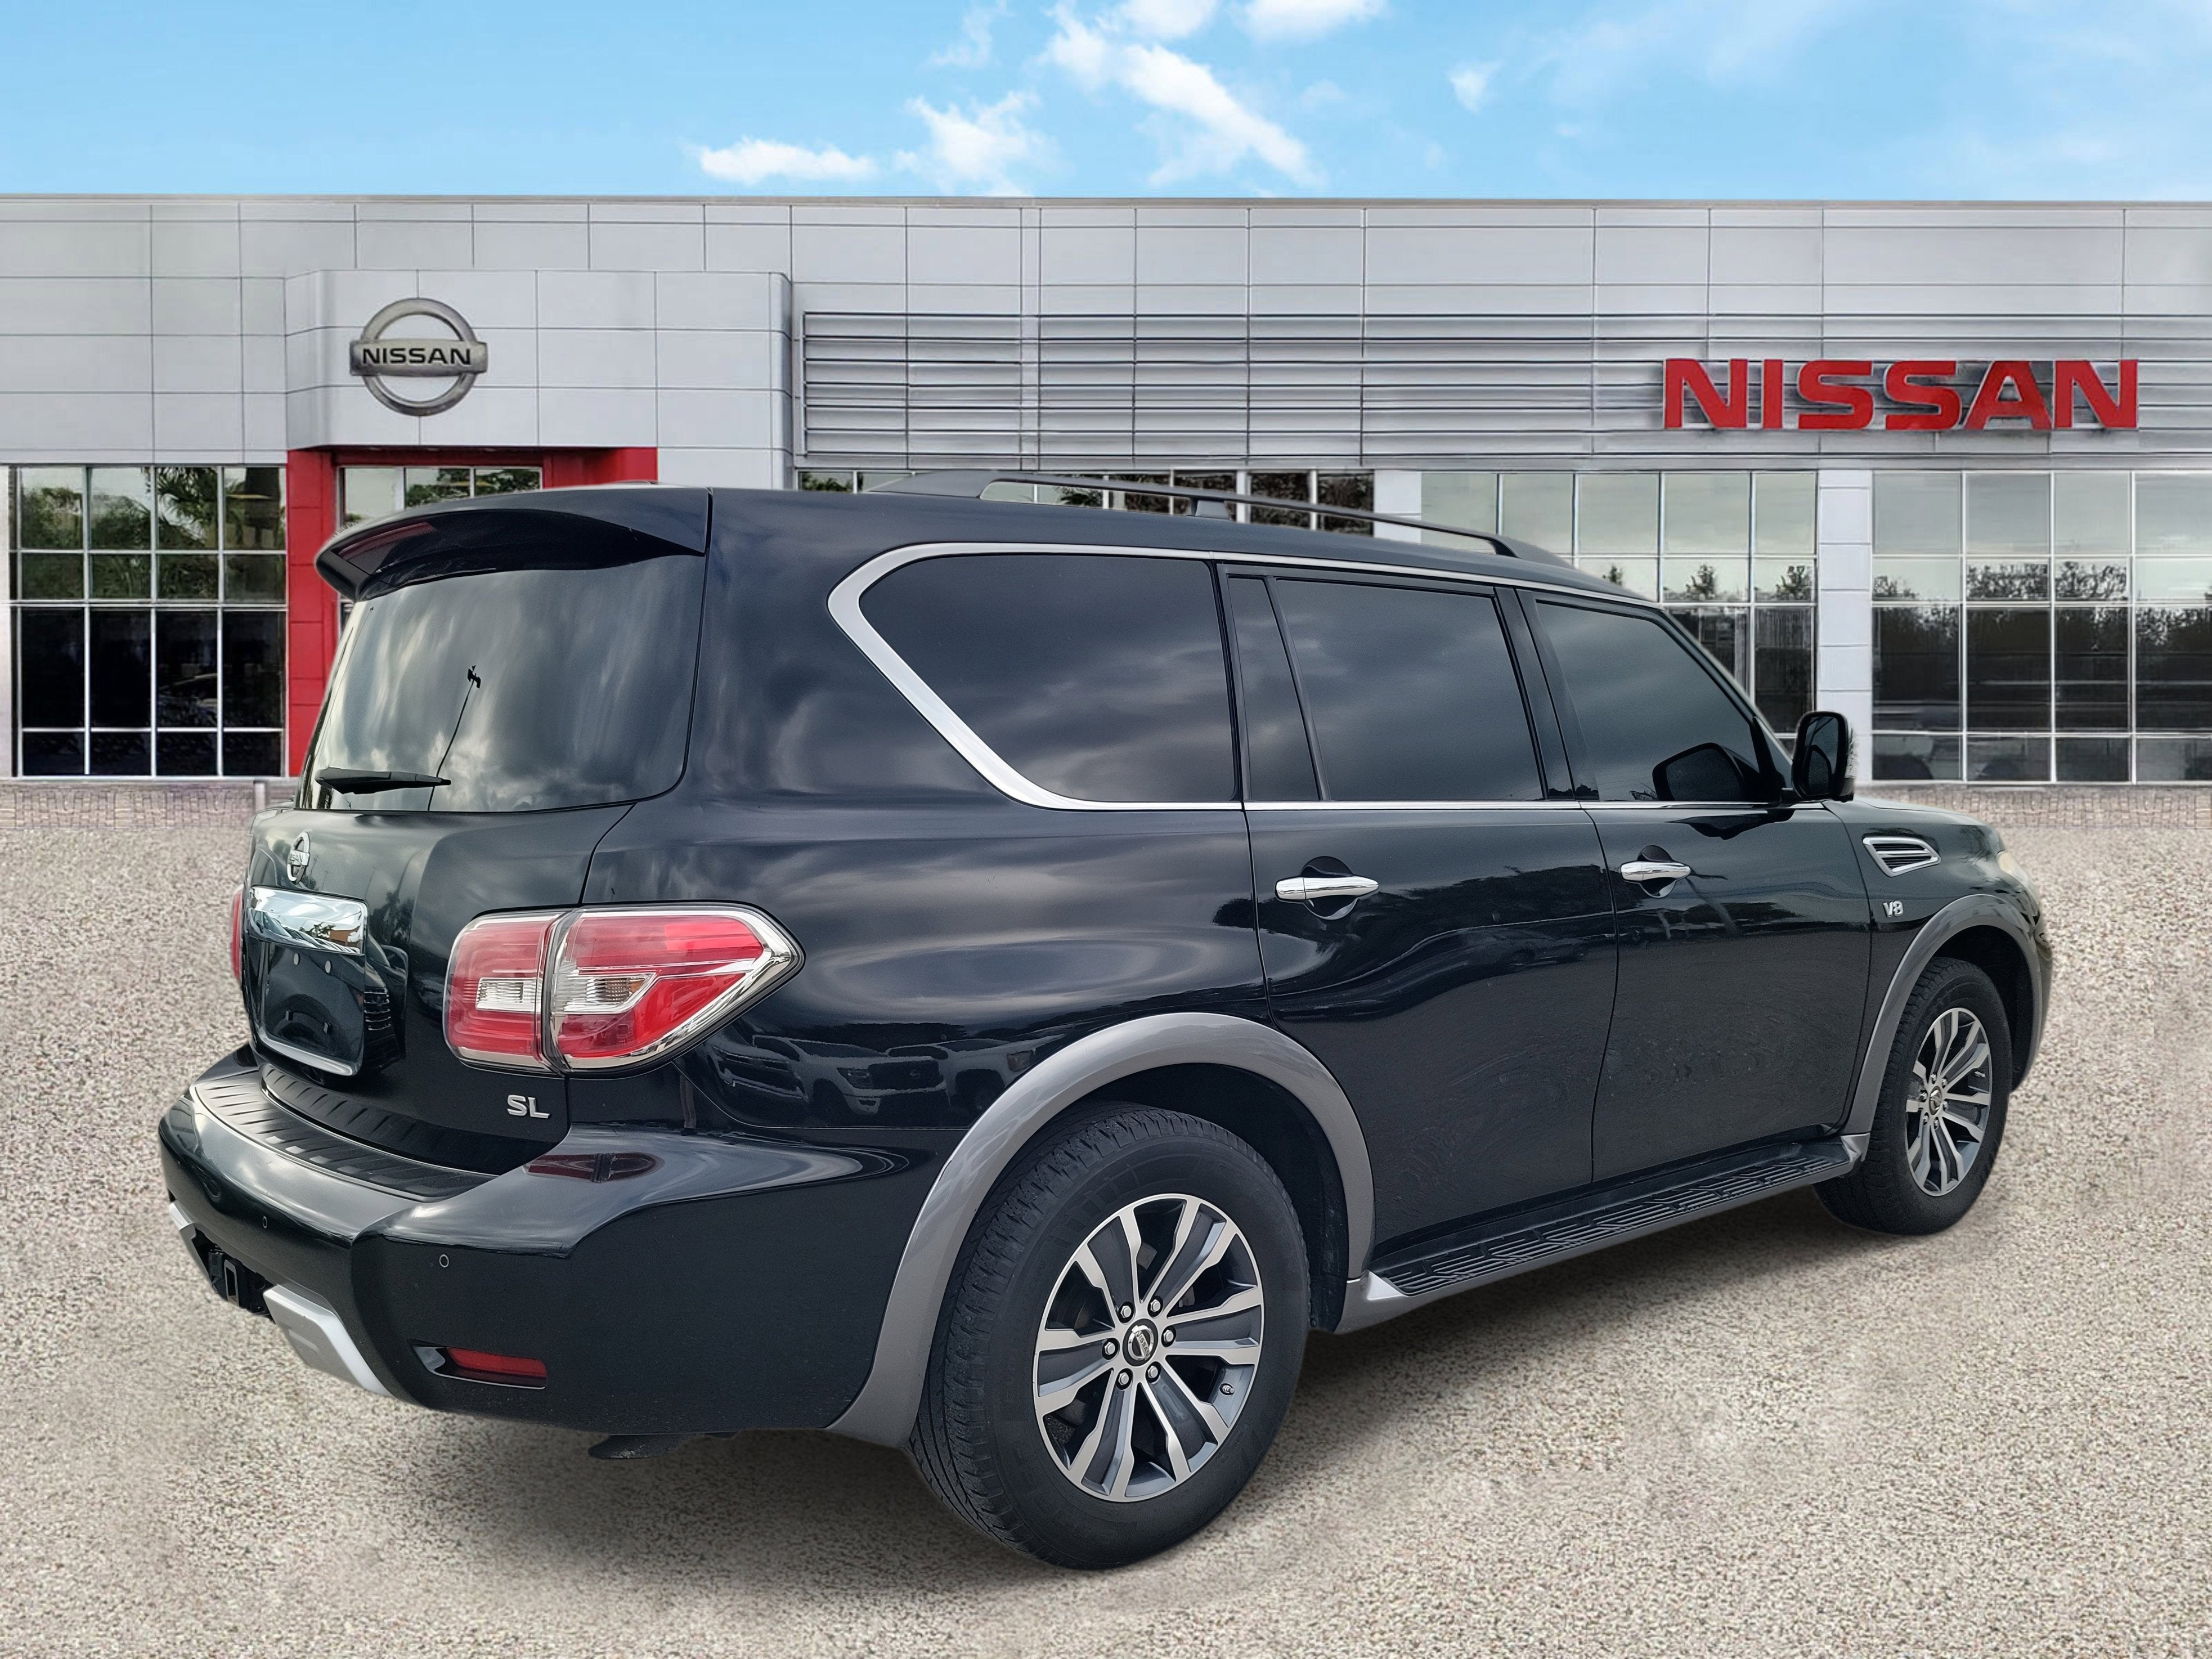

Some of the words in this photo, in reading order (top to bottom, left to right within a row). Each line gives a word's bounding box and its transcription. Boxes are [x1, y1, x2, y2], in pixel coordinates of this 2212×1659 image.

[362, 348, 471, 365] NISSAN
[1663, 358, 2138, 431] NISSAN
[1882, 901, 1904, 917] V8
[507, 1095, 550, 1119] SL
